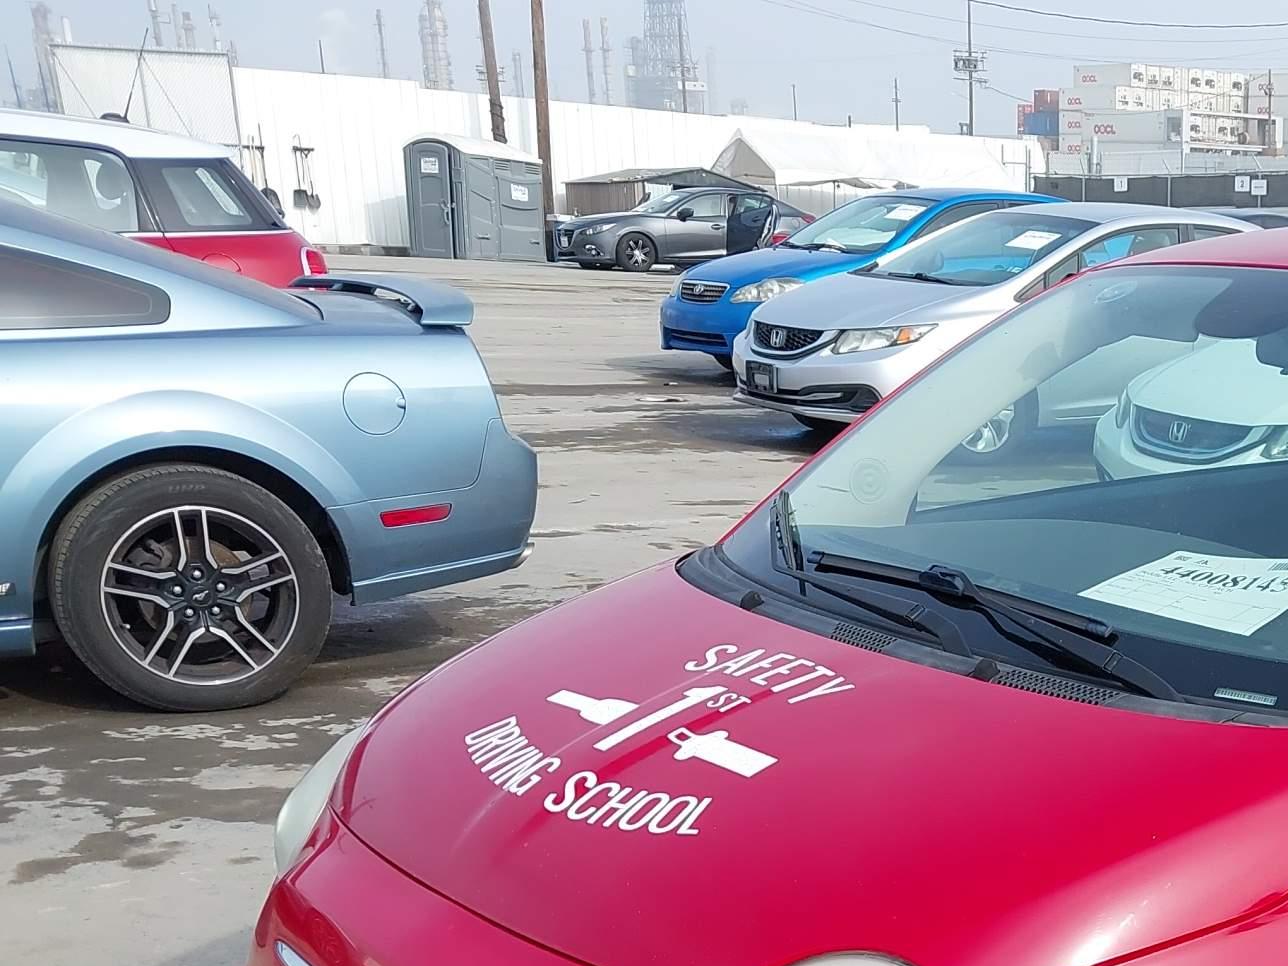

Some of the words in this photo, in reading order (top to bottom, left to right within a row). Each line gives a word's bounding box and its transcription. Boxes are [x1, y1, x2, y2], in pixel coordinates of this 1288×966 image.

[1094, 124, 1116, 135] OOCL
[684, 643, 856, 704] SAFETY
[464, 715, 561, 796] DRIVING
[543, 770, 713, 836] SCHOOL
